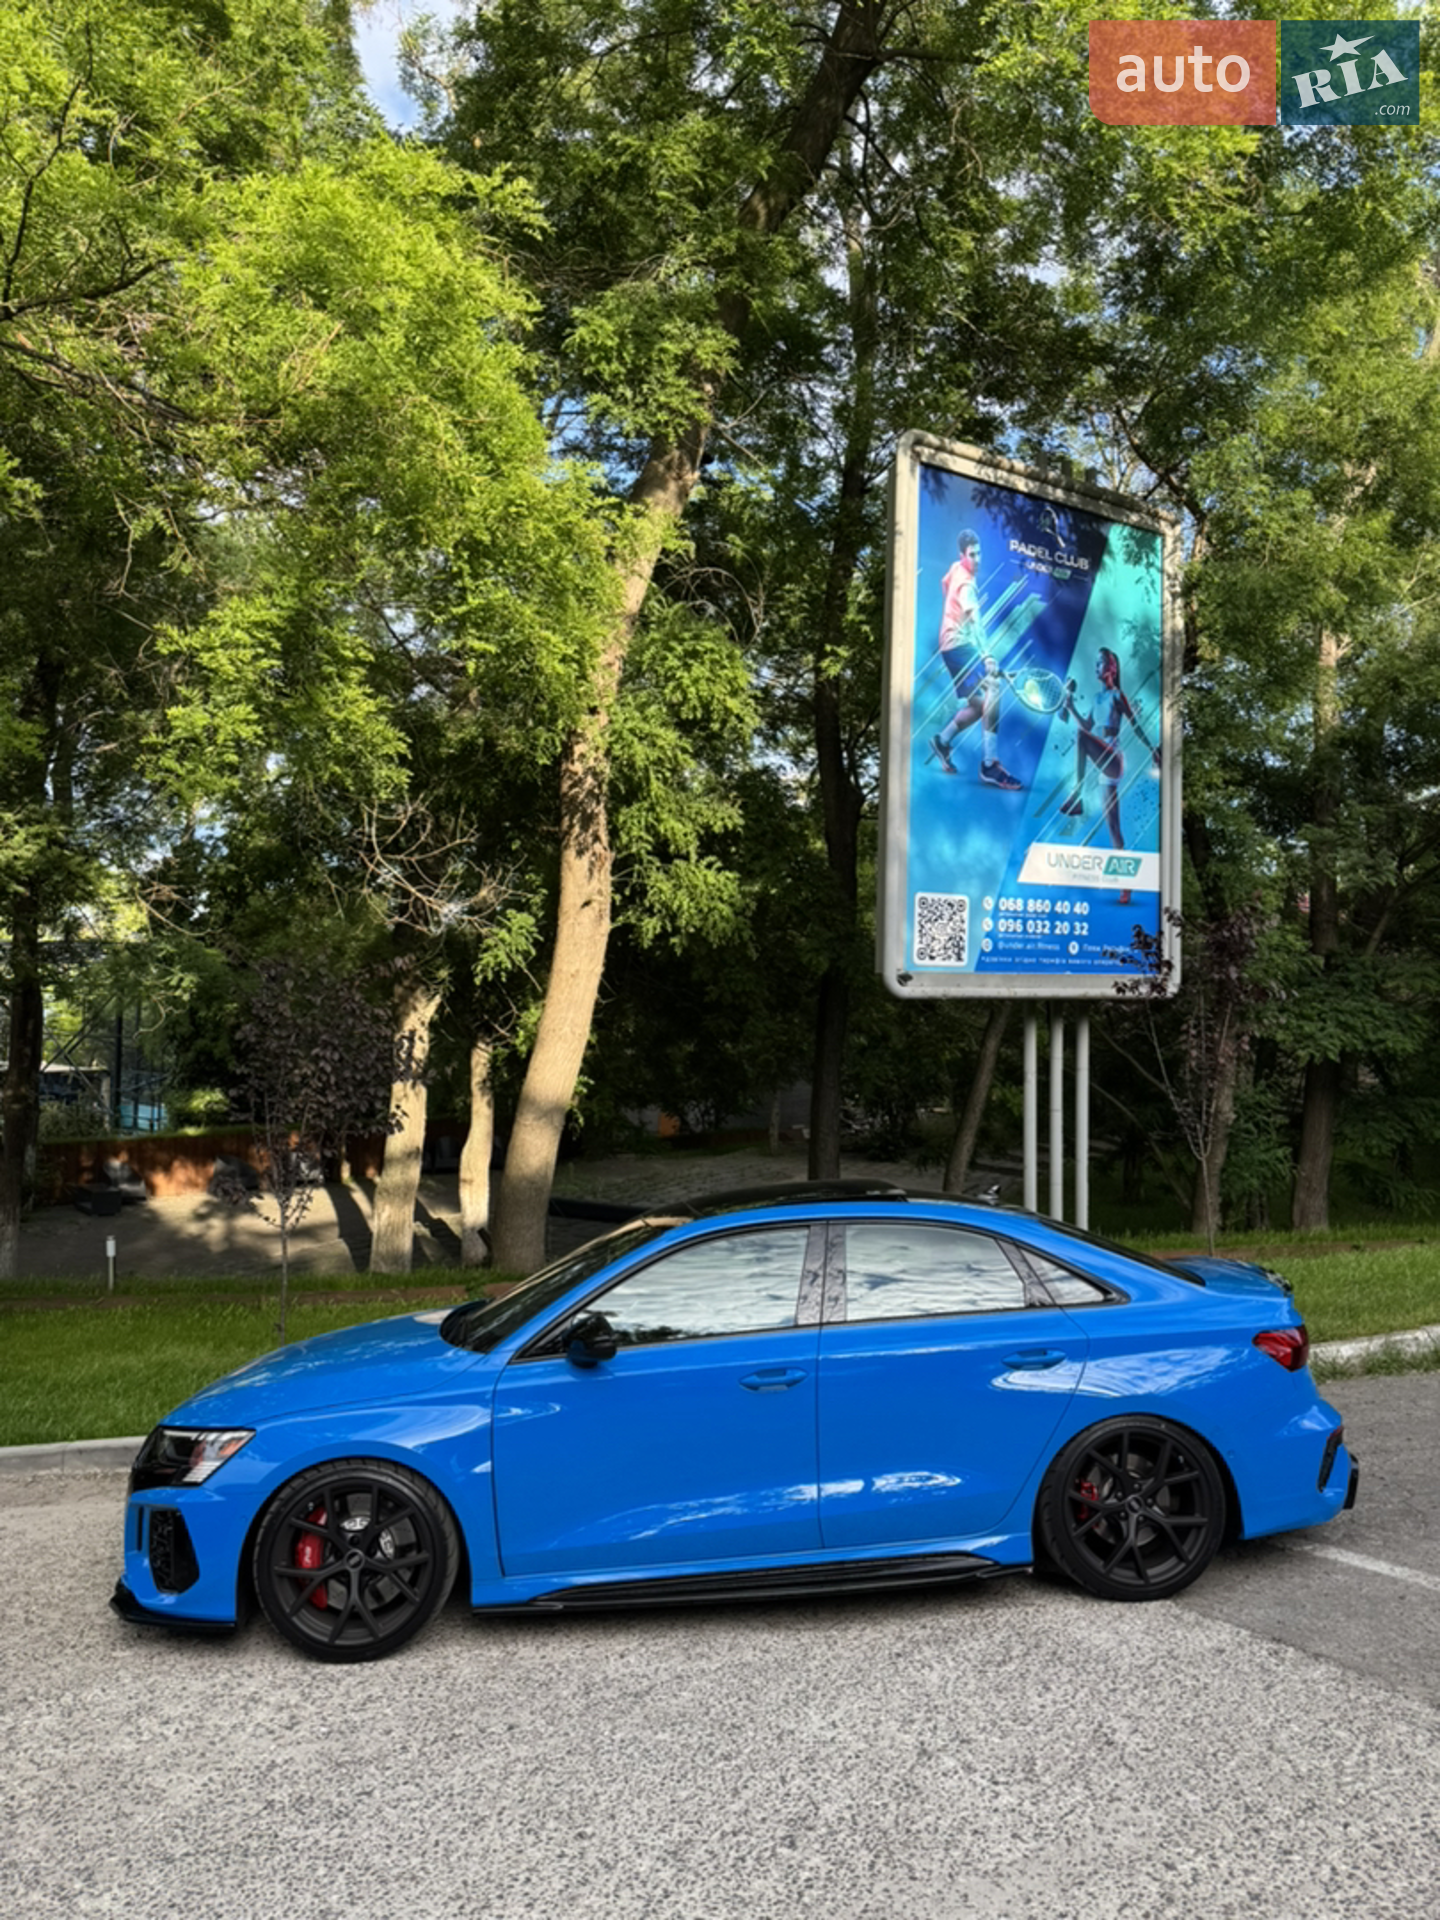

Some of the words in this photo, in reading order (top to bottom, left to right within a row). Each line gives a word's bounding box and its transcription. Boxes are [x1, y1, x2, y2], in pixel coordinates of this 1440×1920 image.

[1009, 539, 1053, 561] PADEL
[1054, 550, 1090, 571] CLUB
[1046, 852, 1103, 871] UNDER
[1108, 858, 1135, 874] AIR
[998, 897, 1023, 912] 068
[1026, 899, 1051, 914] 860
[1054, 900, 1070, 915] 40
[1073, 901, 1090, 916] 40
[998, 918, 1023, 933] 096
[1026, 920, 1051, 935] 032
[1053, 921, 1070, 935] 20
[1073, 922, 1089, 936] 32
